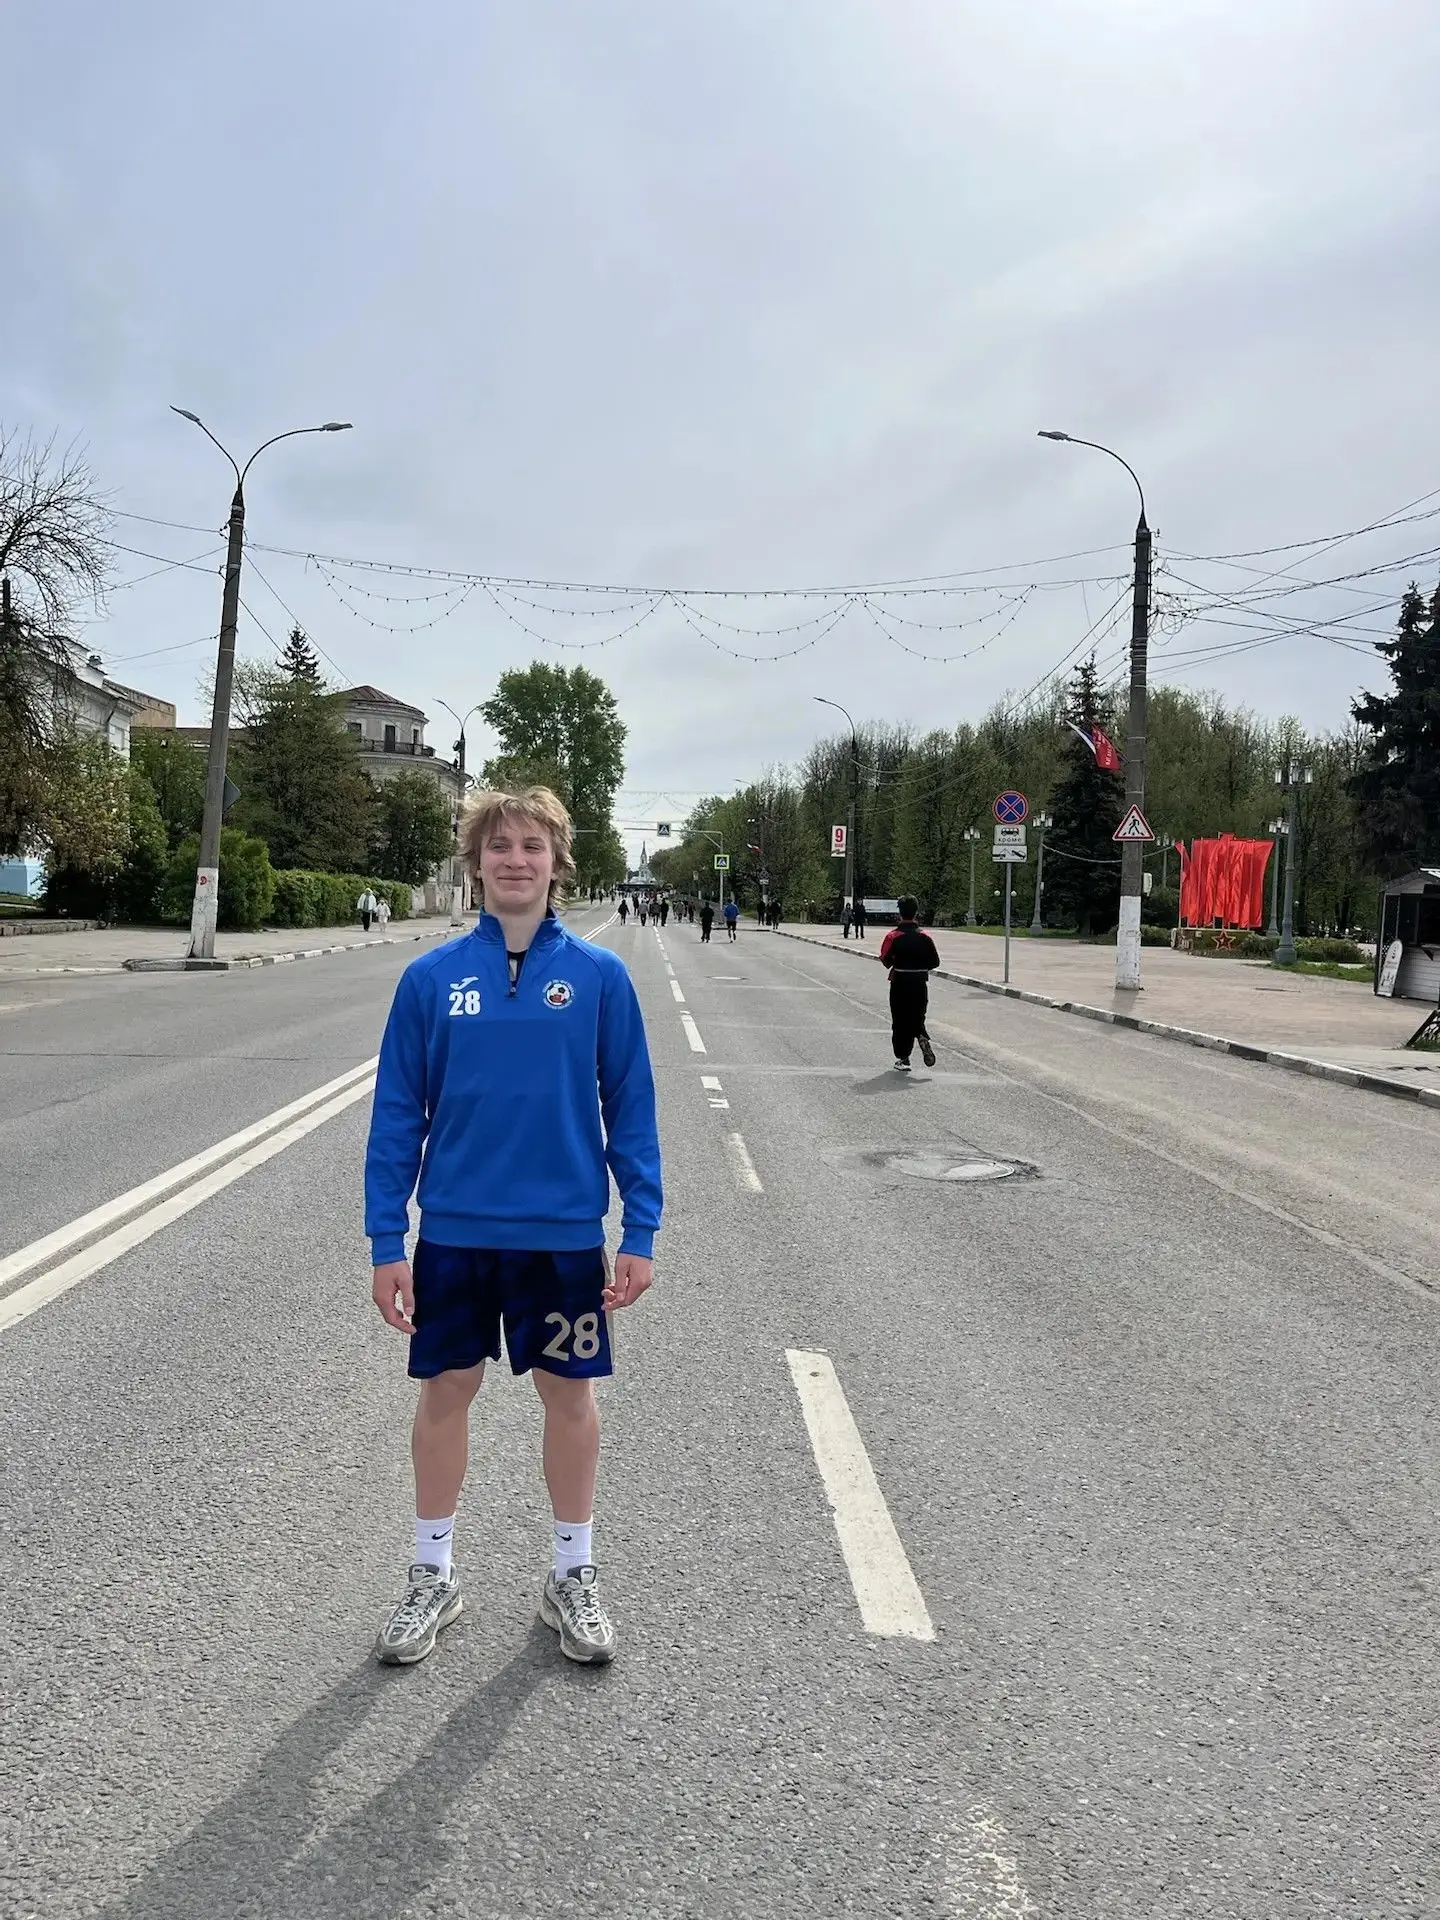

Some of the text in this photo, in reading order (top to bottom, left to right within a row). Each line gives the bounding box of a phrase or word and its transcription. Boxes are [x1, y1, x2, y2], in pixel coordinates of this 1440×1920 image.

[835, 828, 843, 842] 9
[449, 990, 481, 1016] 28
[542, 1312, 600, 1362] 28
